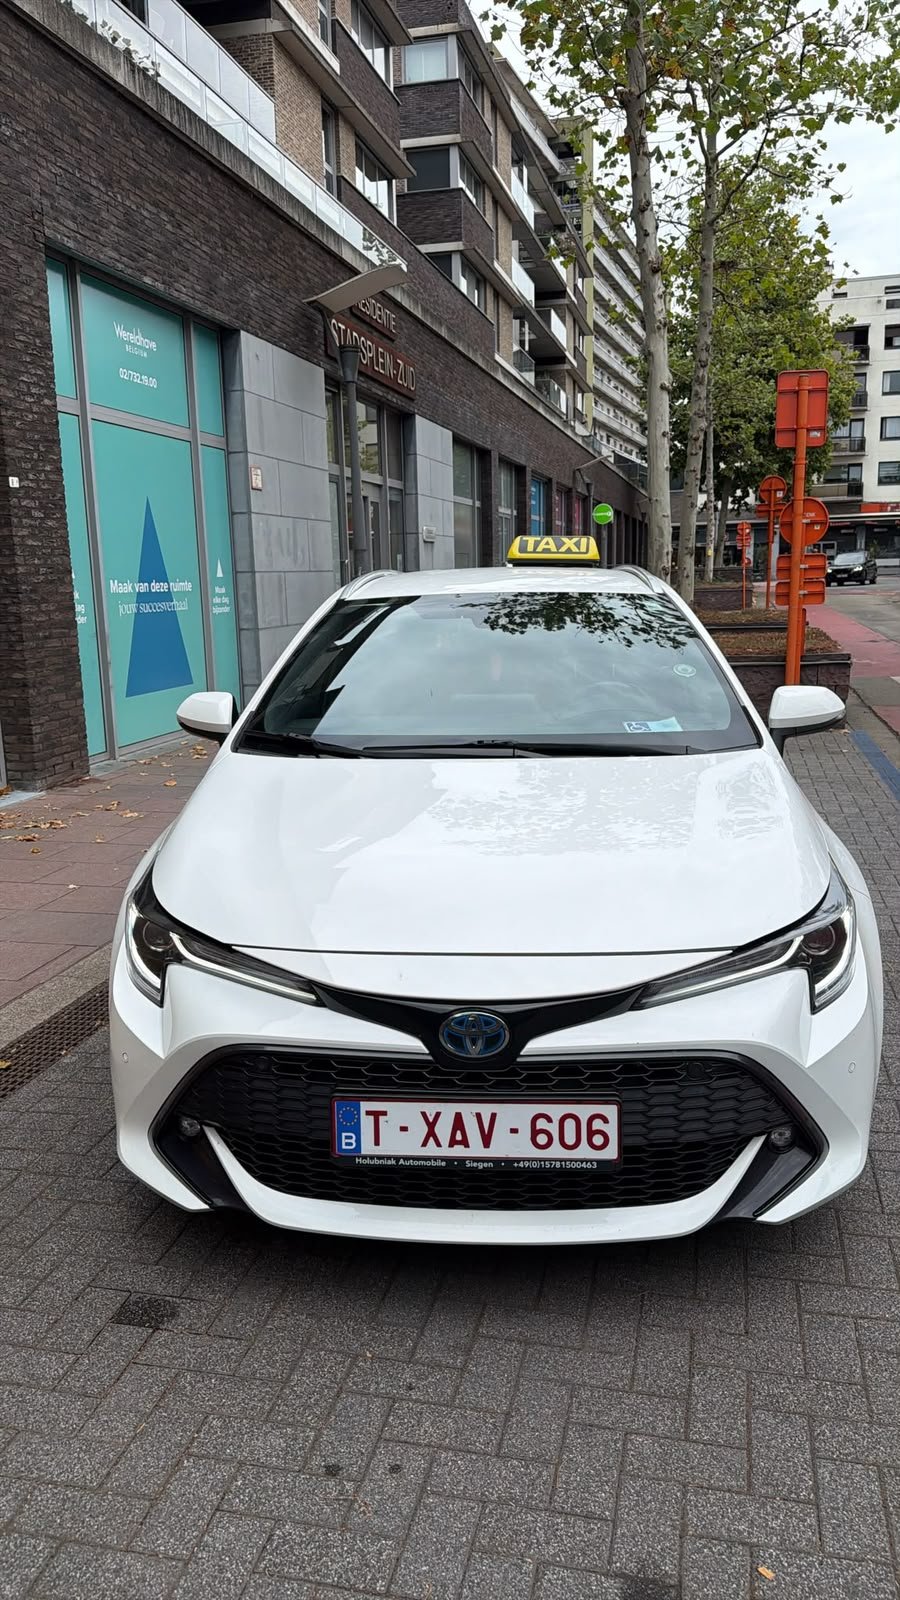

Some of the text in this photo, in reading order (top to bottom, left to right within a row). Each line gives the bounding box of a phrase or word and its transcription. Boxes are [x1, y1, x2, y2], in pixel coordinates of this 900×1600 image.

[355, 297, 397, 333] ESIDENTIE
[113, 320, 157, 352] Wereldhave
[119, 367, 158, 389] 02/732.19.00
[522, 537, 588, 553] TAXI
[110, 579, 192, 594] Maak van deze ruimte
[119, 598, 188, 616] jouw succesverhaal
[365, 1110, 610, 1151] T-XAV-606
[341, 1132, 357, 1150] B
[355, 1157, 597, 1169] Holubniak Automobile Siegen +49(0)15781500463
